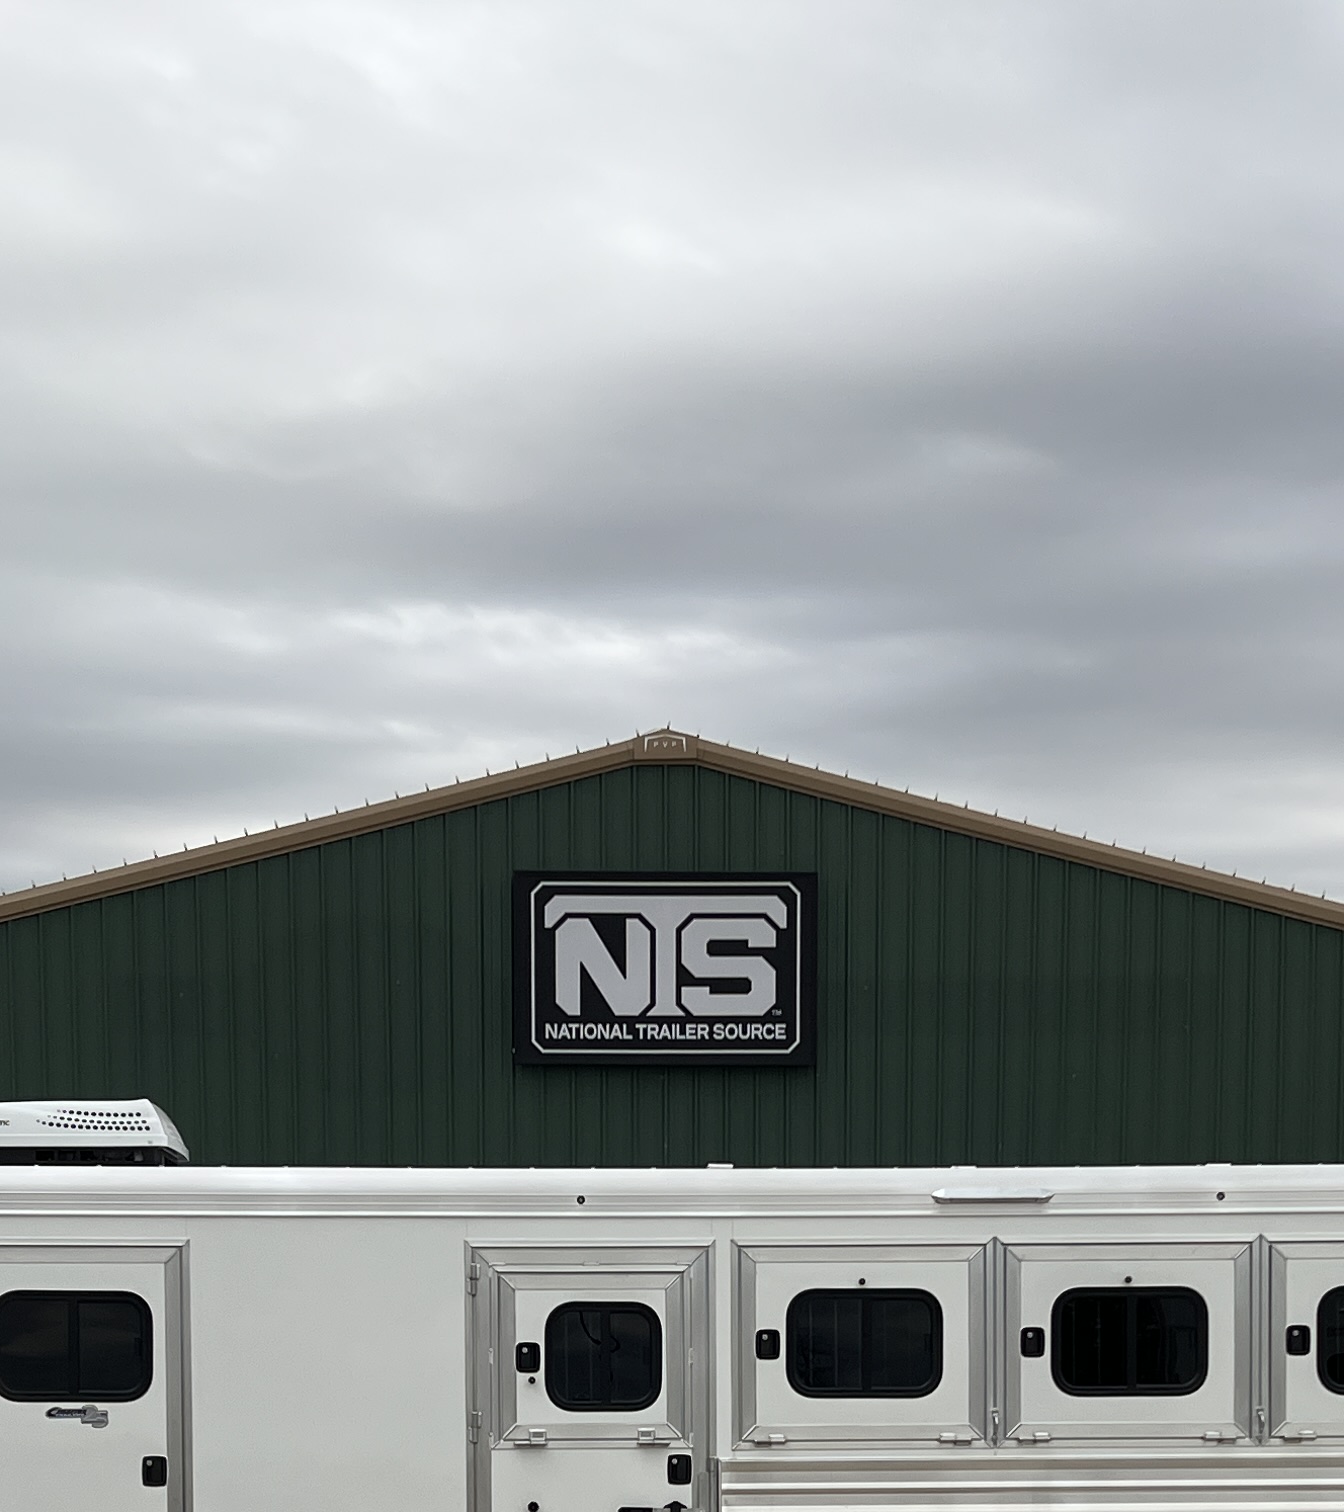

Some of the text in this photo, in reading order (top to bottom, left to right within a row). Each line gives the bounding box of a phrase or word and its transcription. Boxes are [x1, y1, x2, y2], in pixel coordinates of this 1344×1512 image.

[544, 894, 788, 1017] NTS
[545, 1023, 787, 1040] NATIONAL TRAILER SOURCE
